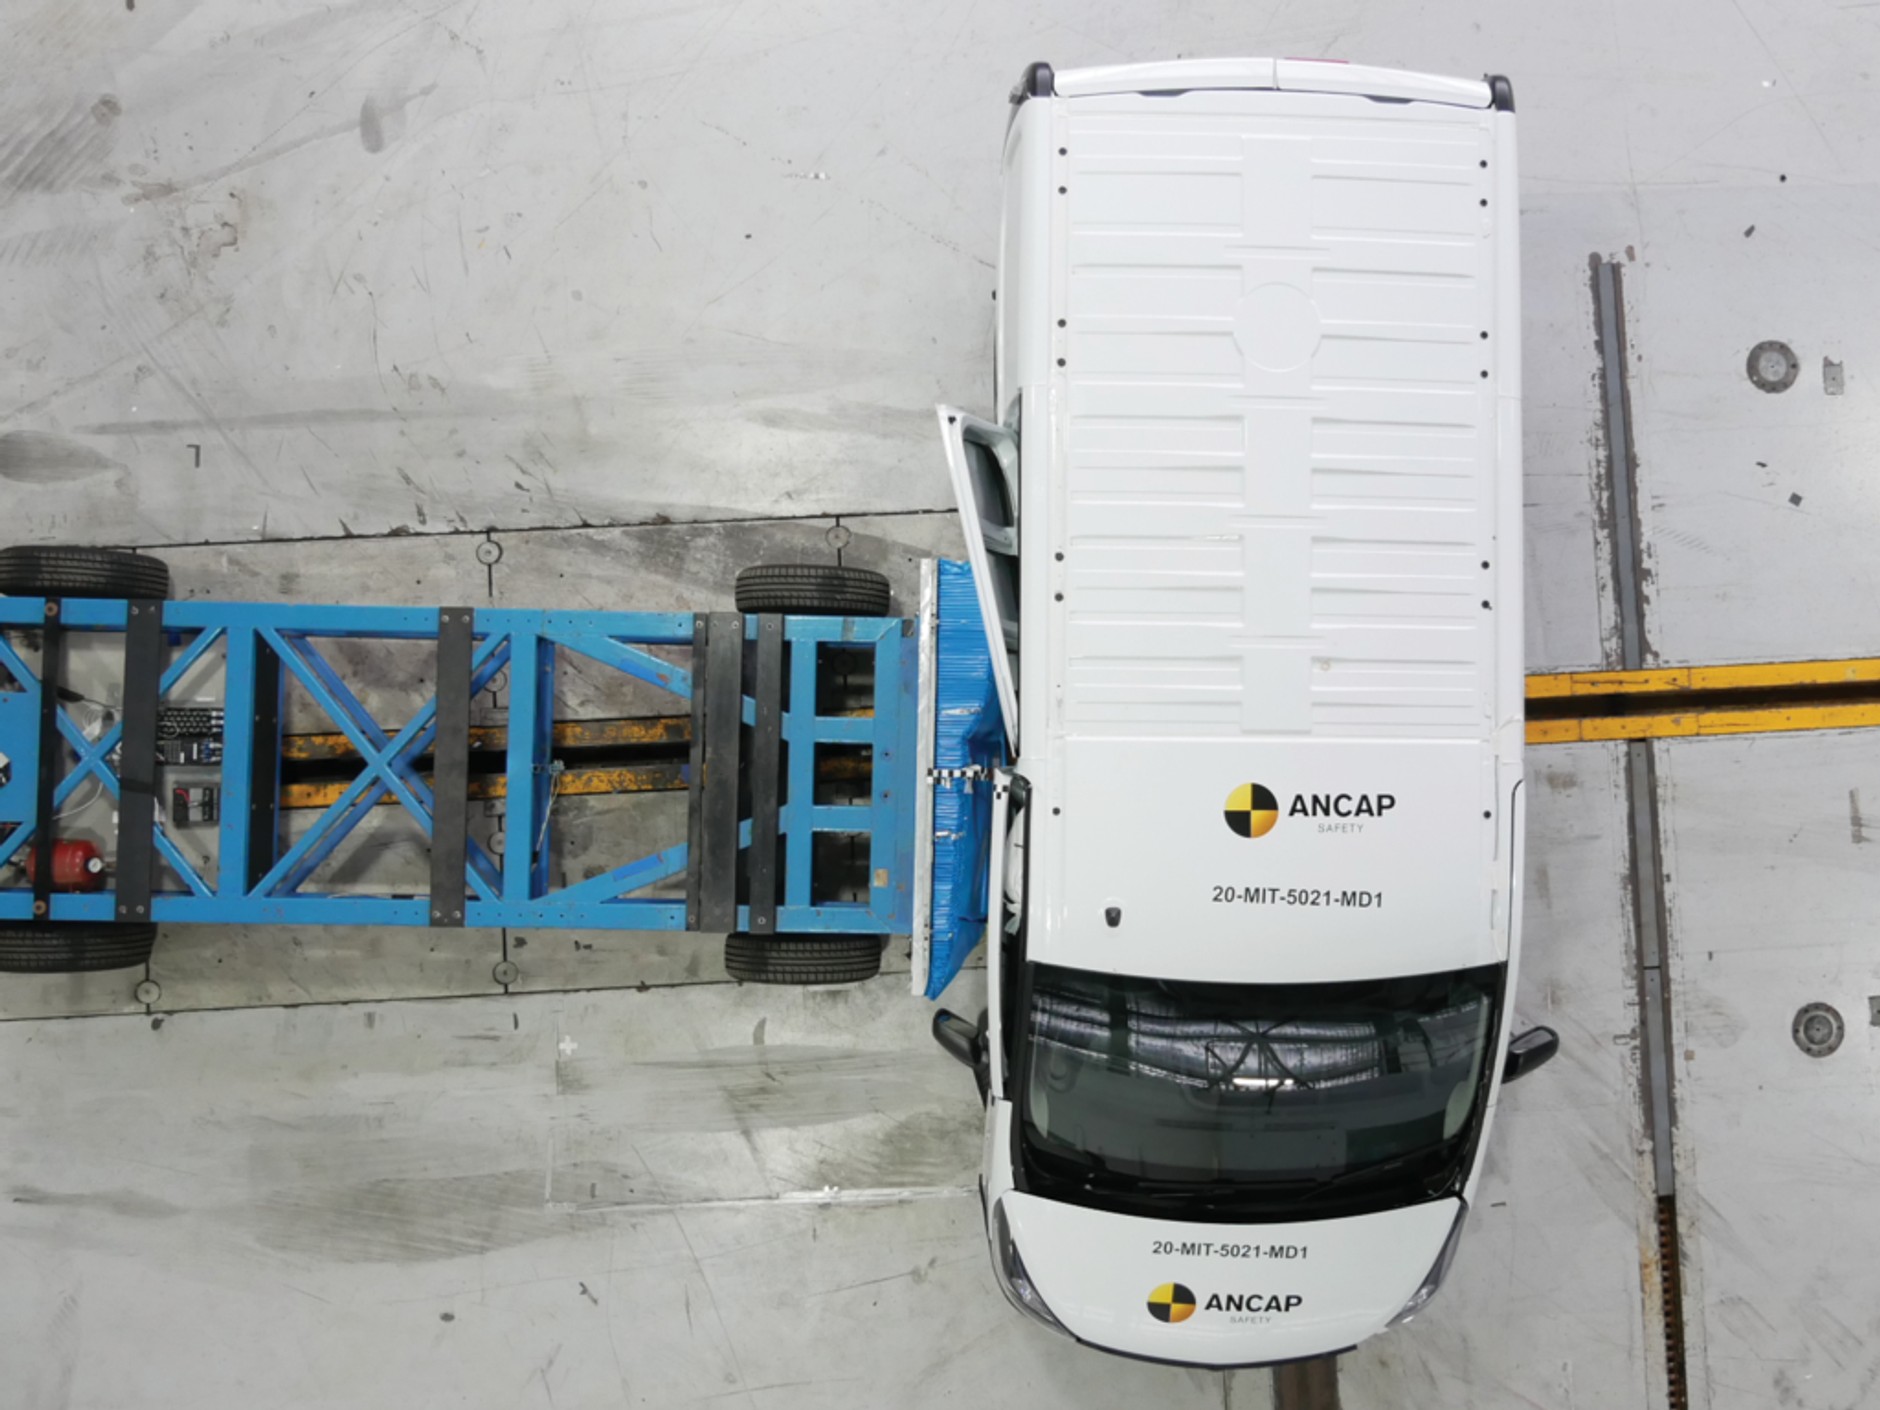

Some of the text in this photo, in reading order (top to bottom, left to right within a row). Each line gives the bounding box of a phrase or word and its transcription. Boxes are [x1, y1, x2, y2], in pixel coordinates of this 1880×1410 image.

[1288, 793, 1396, 817] ANCAP
[1317, 823, 1364, 834] SAFETY
[1212, 885, 1383, 908] 20-MIT-5021-MD1
[1152, 1240, 1308, 1259] 20-MIT-5021-MD1
[1204, 1293, 1303, 1313] ANCAP
[1229, 1316, 1272, 1325] SAFETY
